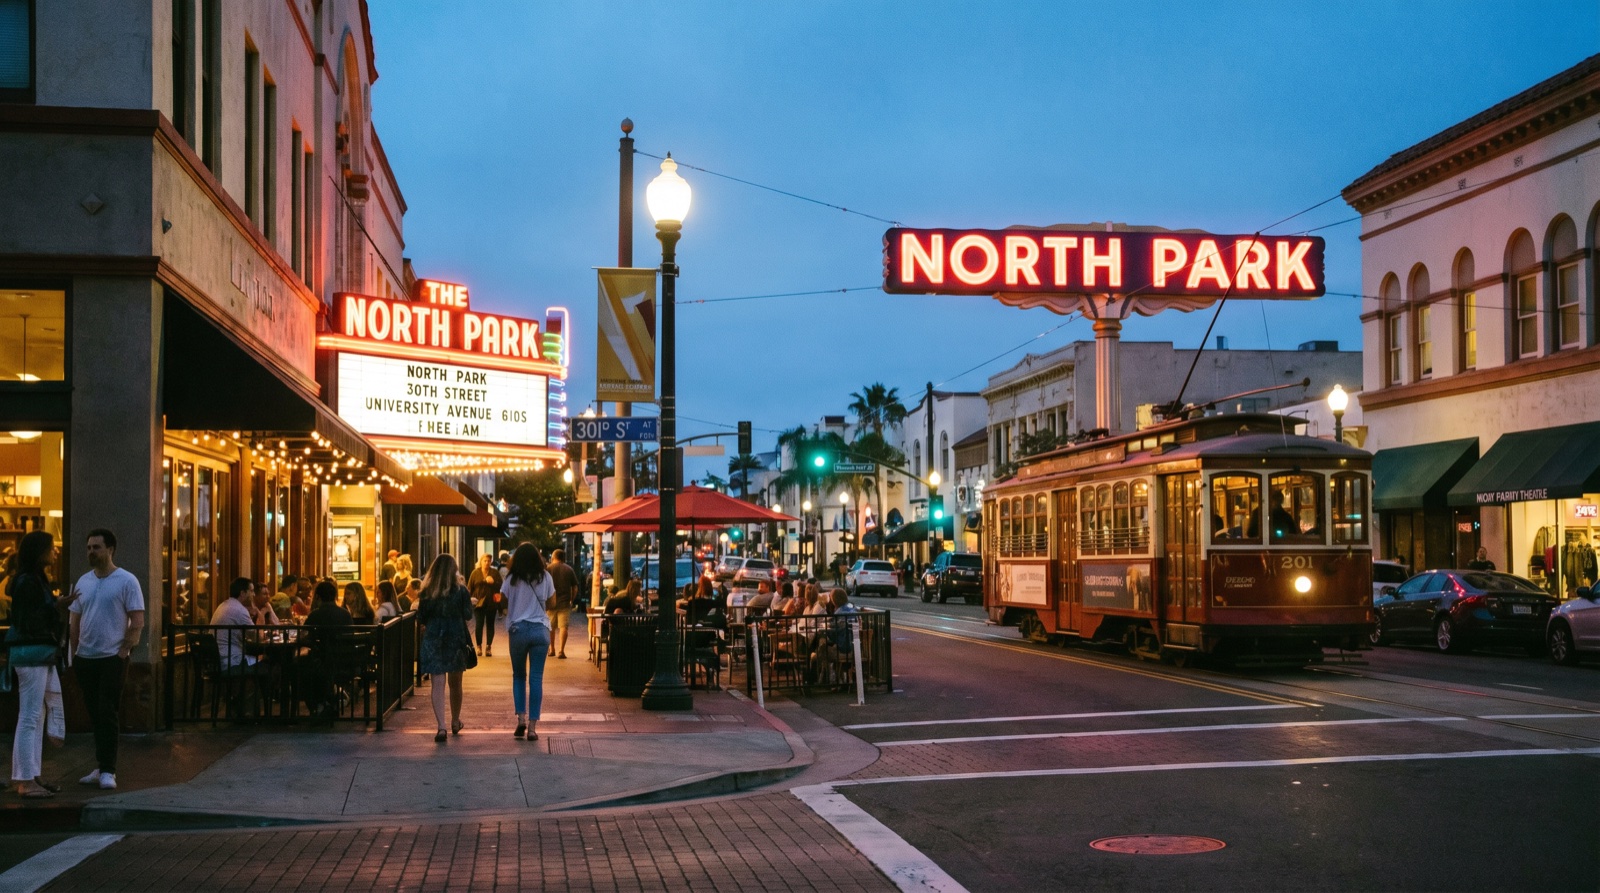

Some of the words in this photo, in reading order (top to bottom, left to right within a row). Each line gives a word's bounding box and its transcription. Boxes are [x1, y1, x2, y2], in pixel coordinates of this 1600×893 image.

[901, 234, 1122, 287] NORTH
[1152, 238, 1316, 290] PARK
[426, 281, 468, 307] THE
[345, 296, 450, 347] NORTH
[464, 313, 540, 359] PARK
[407, 364, 447, 381] NORTH
[457, 370, 487, 385] PARK
[407, 383, 437, 398] 30TH
[444, 386, 487, 402] STREET
[365, 397, 439, 416] UNIVERSITY
[447, 404, 492, 420] AVENUE
[1520, 488, 1548, 500] THEATRE
[1281, 556, 1314, 569] 201
